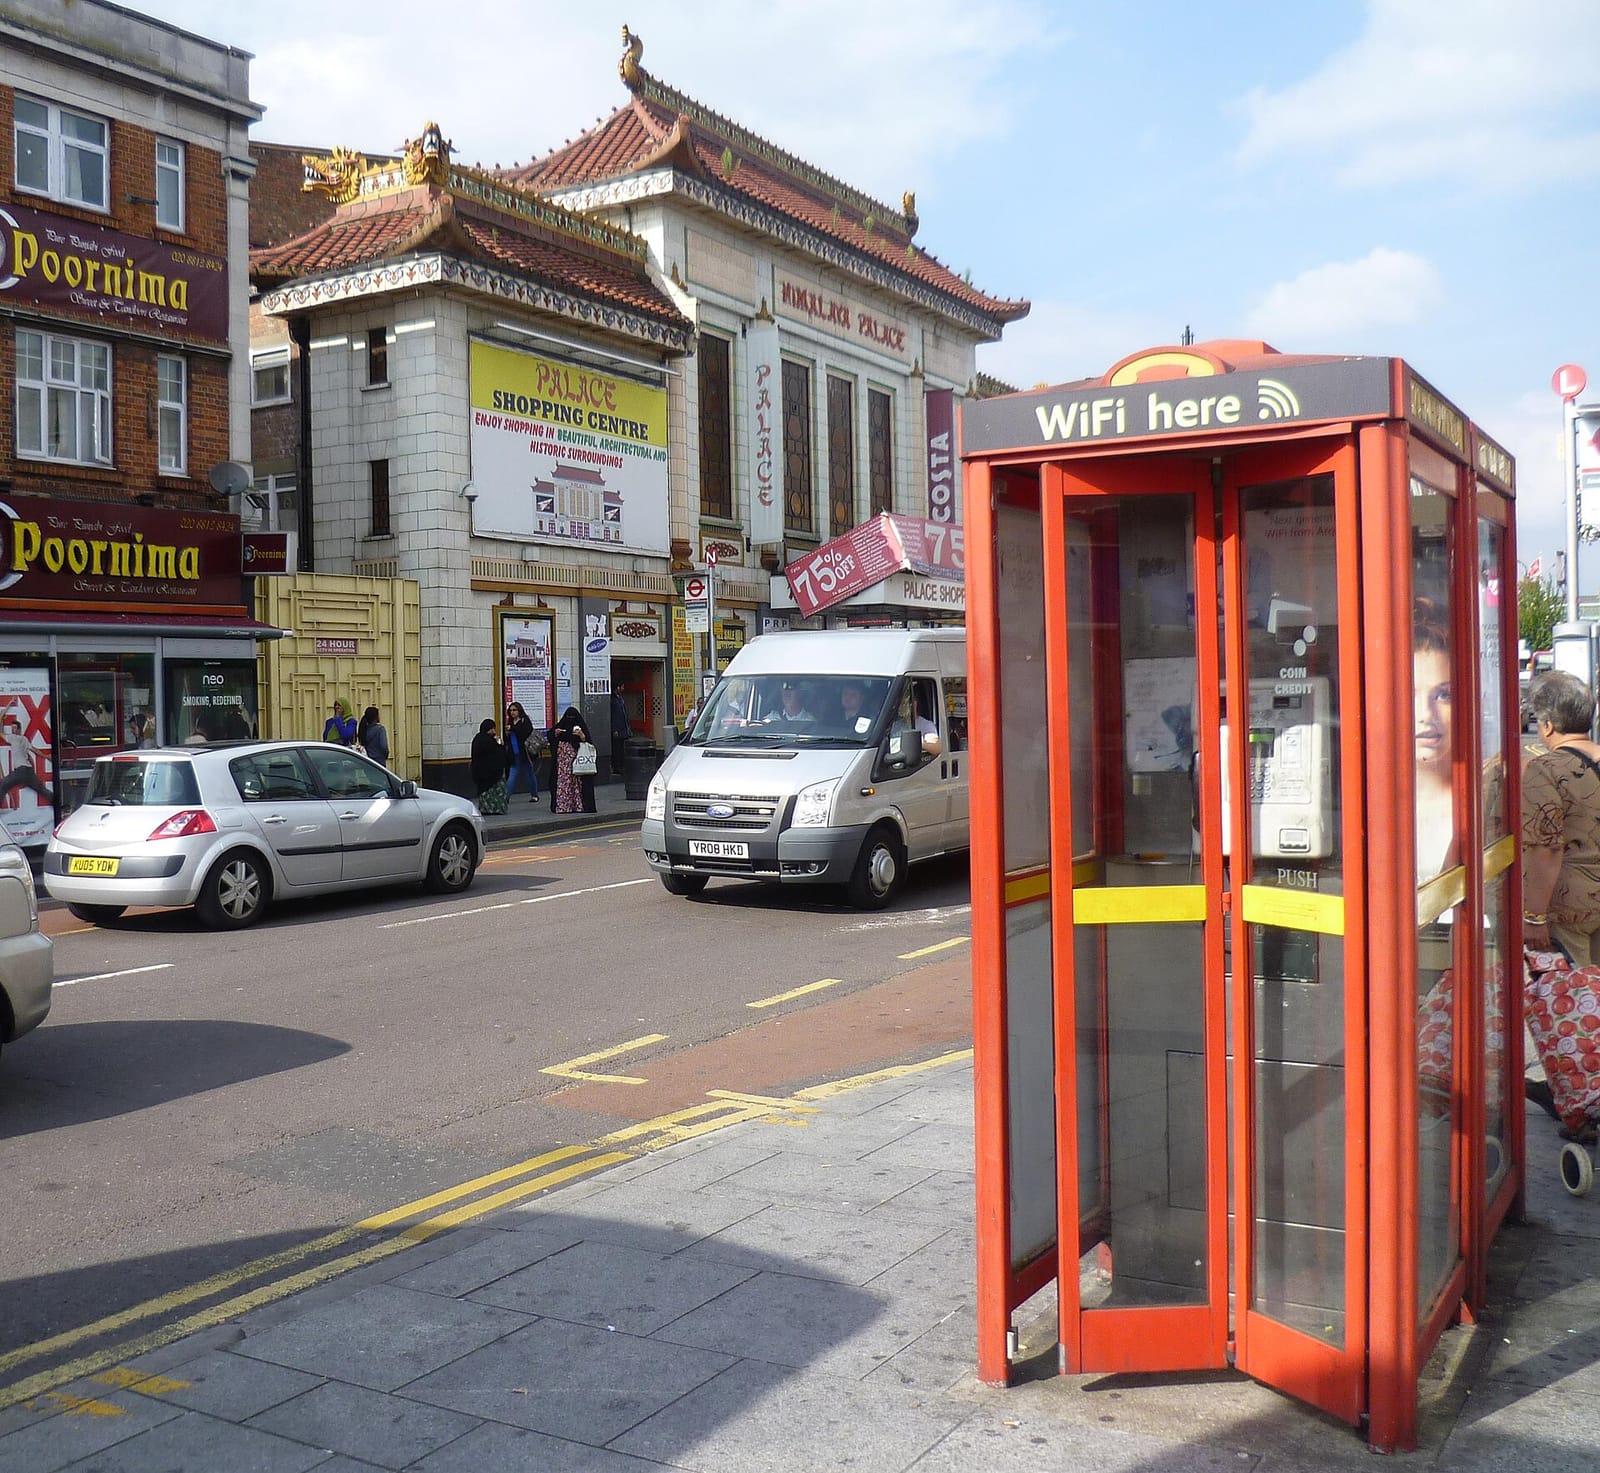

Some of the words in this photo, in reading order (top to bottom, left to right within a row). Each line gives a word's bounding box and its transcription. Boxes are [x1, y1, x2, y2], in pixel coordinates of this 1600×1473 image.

[12, 229, 189, 311] Poornima
[857, 312, 905, 352] PALACE
[536, 361, 617, 412] PALACE
[1559, 369, 1578, 394] L
[493, 389, 584, 427] SHOPPING
[587, 410, 649, 441] CENTRE
[1034, 398, 1126, 441] WiFi
[1148, 393, 1241, 431] here
[475, 411, 503, 430] ENJOY
[503, 417, 545, 438] SHOPPING
[546, 427, 555, 439] IN
[557, 428, 599, 450] BEAUTIFUL,
[599, 438, 653, 461] ARCHITECTURAL
[653, 450, 667, 463] AND
[530, 440, 566, 459] HISTORIC
[567, 447, 624, 469] SURROUNDINGS
[930, 431, 951, 522] COSTA
[12, 520, 200, 580] Poornima
[706, 551, 716, 564] N
[793, 548, 842, 608] 75%
[834, 554, 857, 581] OFF
[904, 580, 938, 602] PALACE
[316, 640, 327, 648] 24
[329, 640, 356, 648] HOUR
[202, 674, 225, 686] neo
[1280, 667, 1307, 679] COIN
[182, 695, 212, 708] SMOKING,
[212, 695, 245, 706] REDEFINED.
[1275, 683, 1313, 695] CREDIT
[693, 842, 720, 854] YR08
[722, 843, 744, 856] HKD
[72, 858, 95, 871] KU05
[1277, 868, 1317, 888] PUSH
